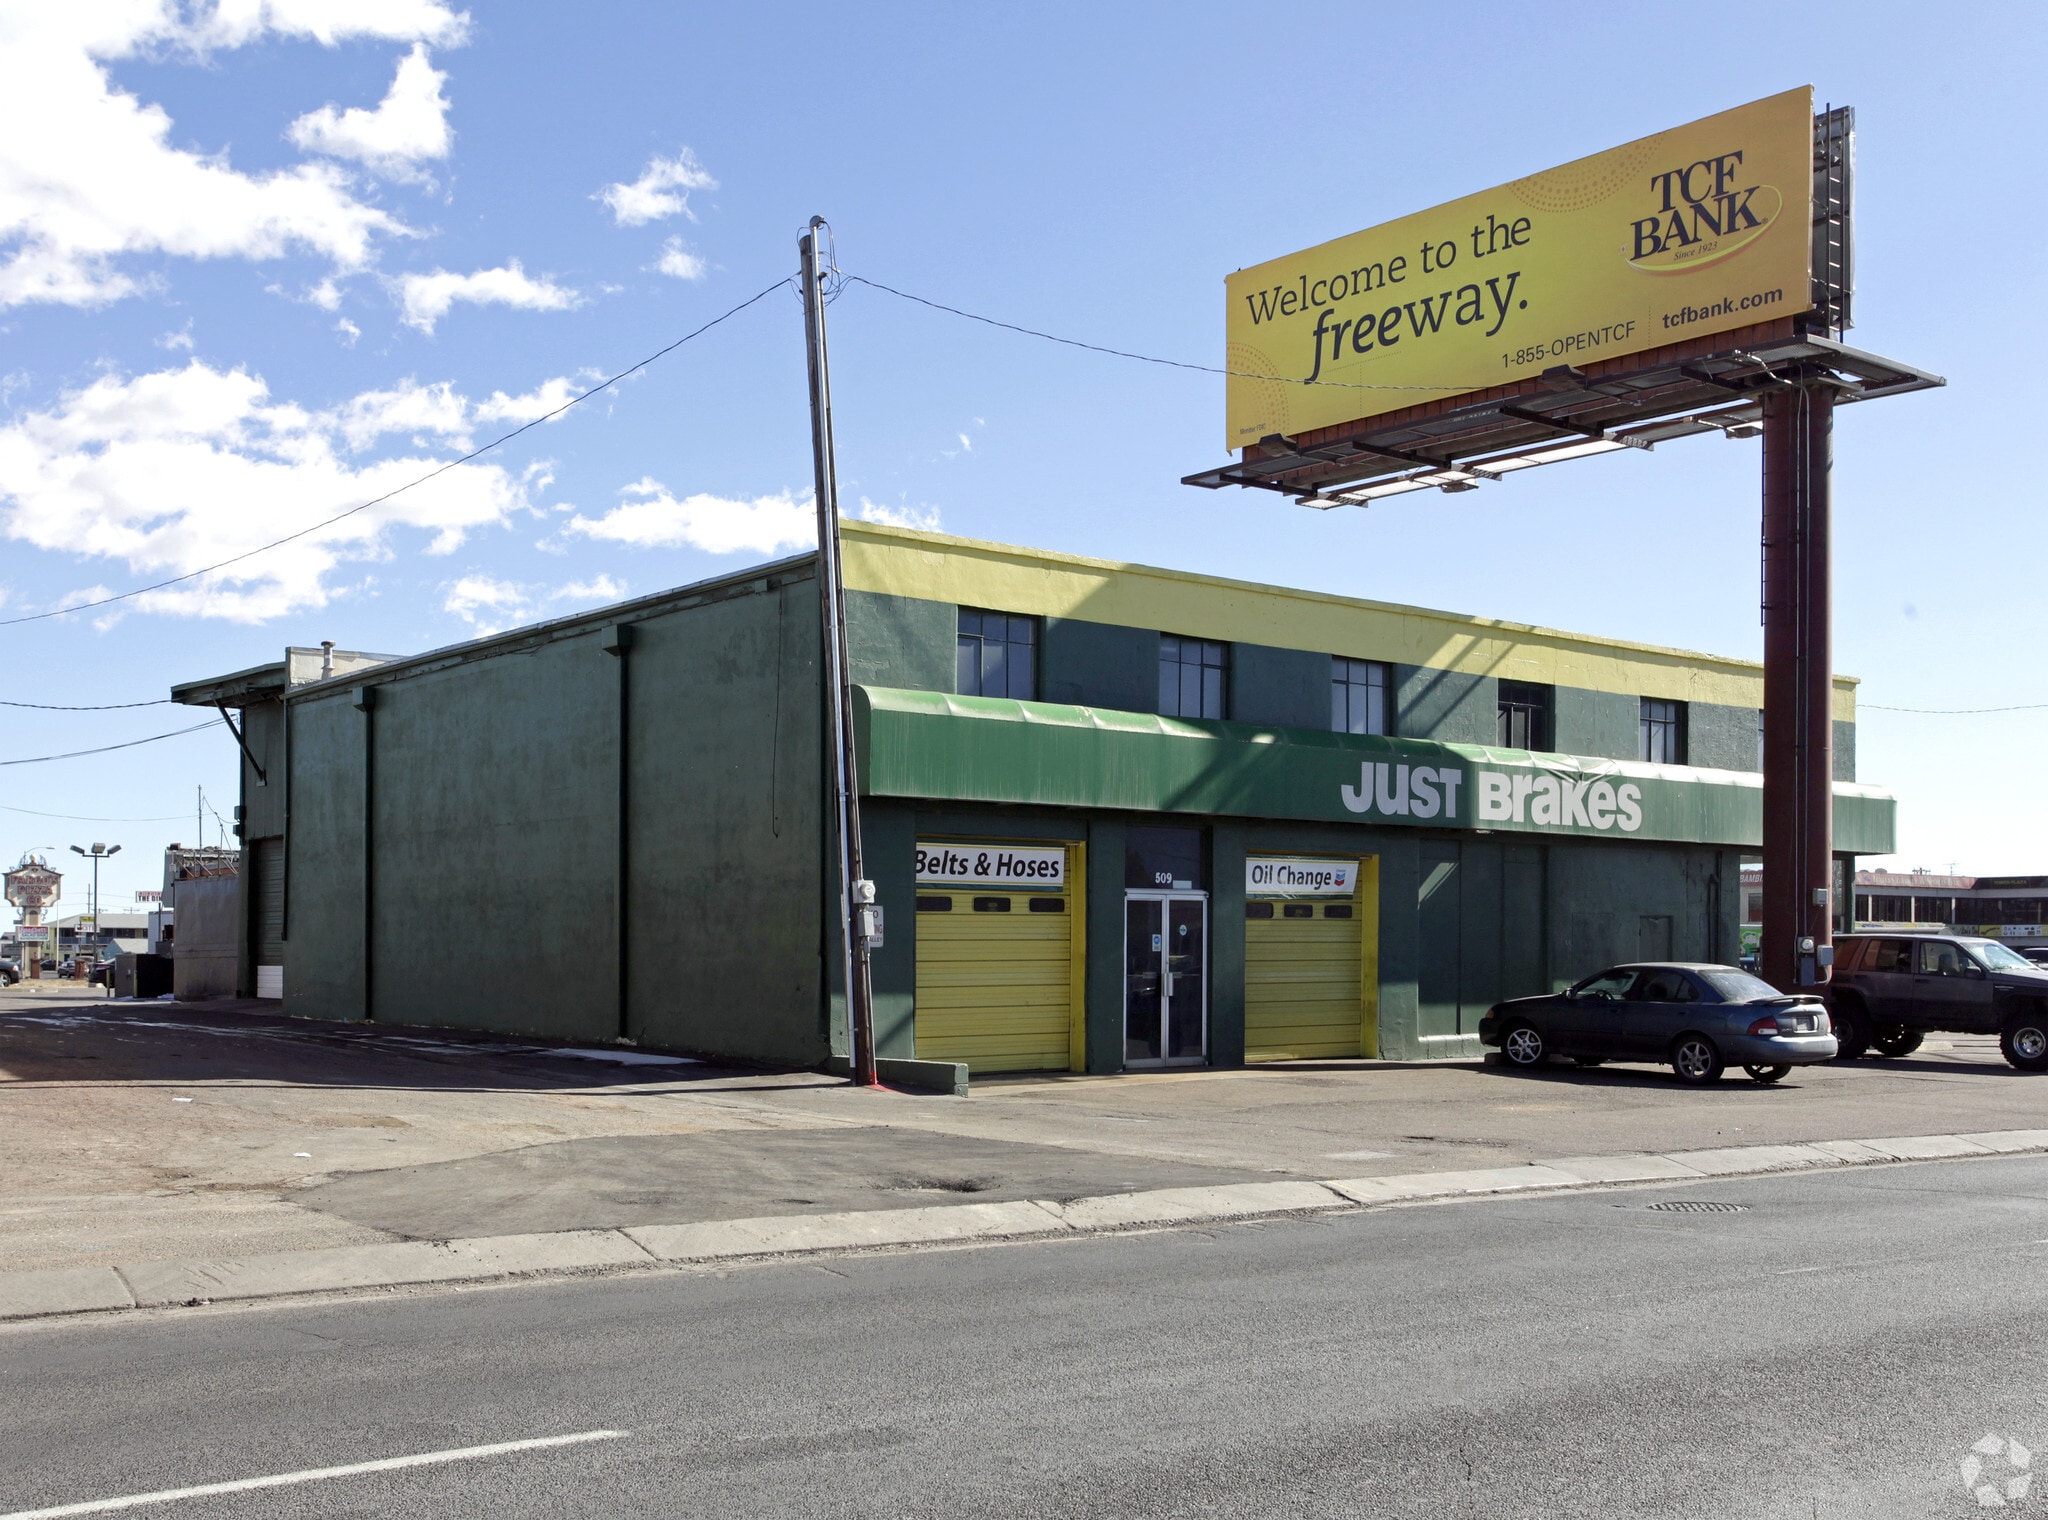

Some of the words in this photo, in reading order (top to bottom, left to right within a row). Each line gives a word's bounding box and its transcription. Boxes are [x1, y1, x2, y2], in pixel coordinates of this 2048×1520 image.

[1651, 150, 1743, 214] TCF
[1630, 186, 1761, 261] BANK
[1246, 255, 1407, 325] Welcome
[1421, 240, 1457, 274] to
[1471, 214, 1531, 258] the
[1673, 249, 1696, 261] Since
[1697, 241, 1718, 255] 1923
[1304, 271, 1528, 385] freeway.
[1662, 288, 1784, 329] tcfbank.com
[1502, 320, 1636, 369] 1-855-OPENTCF
[1478, 771, 1643, 832] Brakes
[915, 850, 969, 875] Belts
[974, 852, 991, 876] &
[996, 853, 1060, 878] Hoses
[1155, 872, 1173, 884] 509
[1252, 864, 1274, 885] Oil
[1277, 866, 1332, 890] Change
[17, 885, 53, 895] PIZZA
